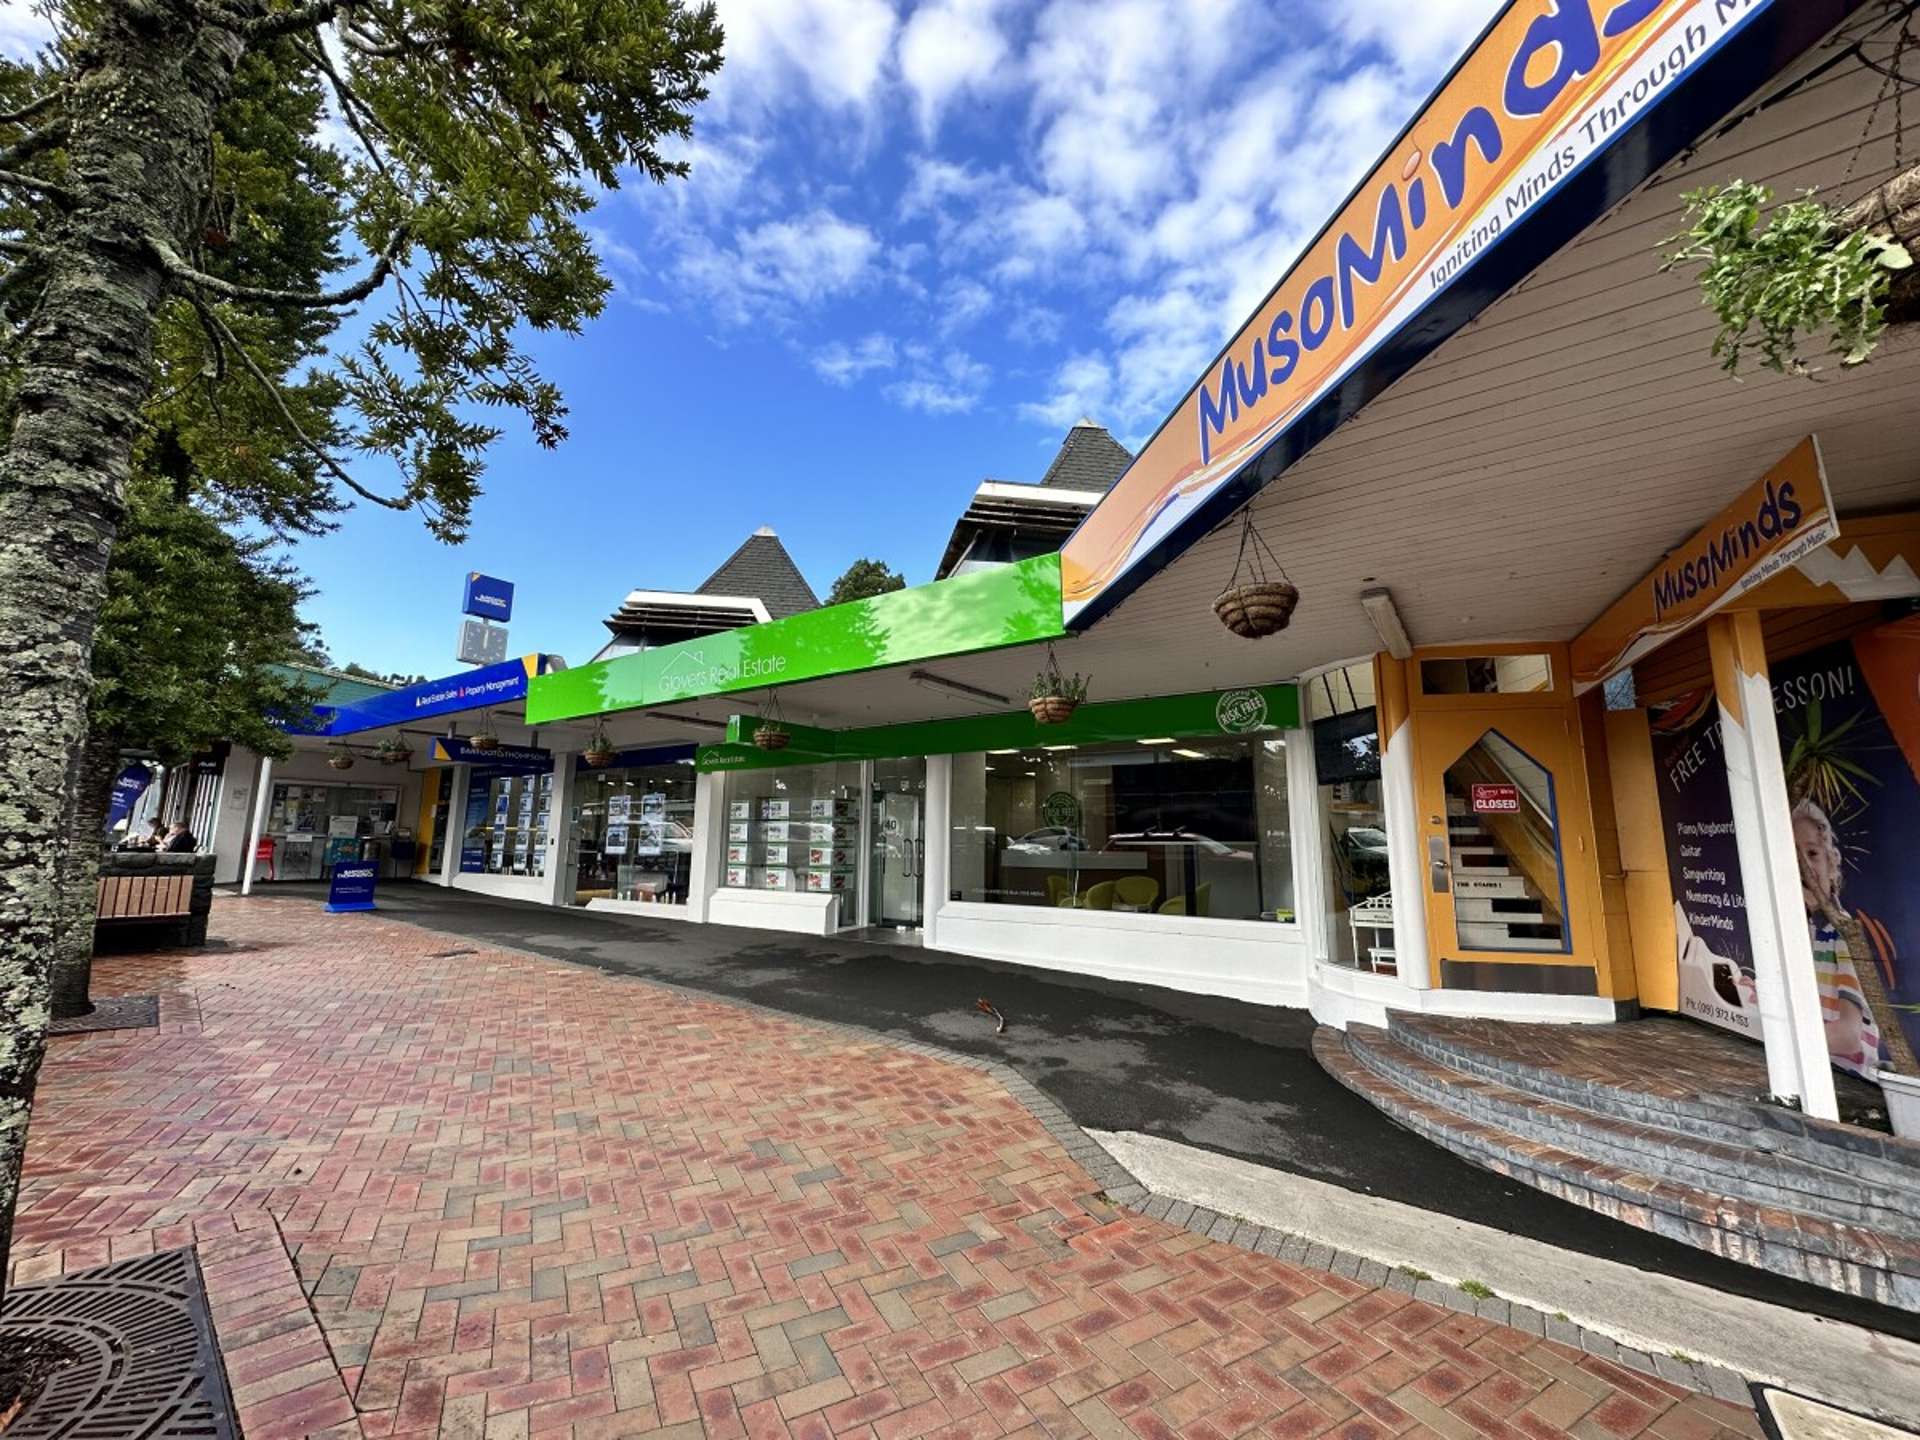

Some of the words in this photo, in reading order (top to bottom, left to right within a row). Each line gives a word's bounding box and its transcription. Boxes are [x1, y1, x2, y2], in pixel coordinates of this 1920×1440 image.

[1429, 216, 1502, 289] Igniting
[1505, 146, 1576, 220] Minds
[1579, 24, 1706, 145] Through
[1654, 480, 1802, 623] MusoMinds
[660, 671, 708, 691] Glovers
[709, 663, 741, 683] Real
[743, 655, 786, 678] Estate
[1220, 705, 1241, 725] RISK
[1240, 696, 1264, 713] FREE
[1669, 741, 1707, 793] FREE
[1476, 799, 1517, 809] CLOSED
[1680, 843, 1702, 857] Guitar
[1682, 866, 1726, 886] Songwriting
[1685, 888, 1722, 909] Numeracy
[1722, 892, 1731, 907] &
[1688, 911, 1735, 931] KinderMinds
